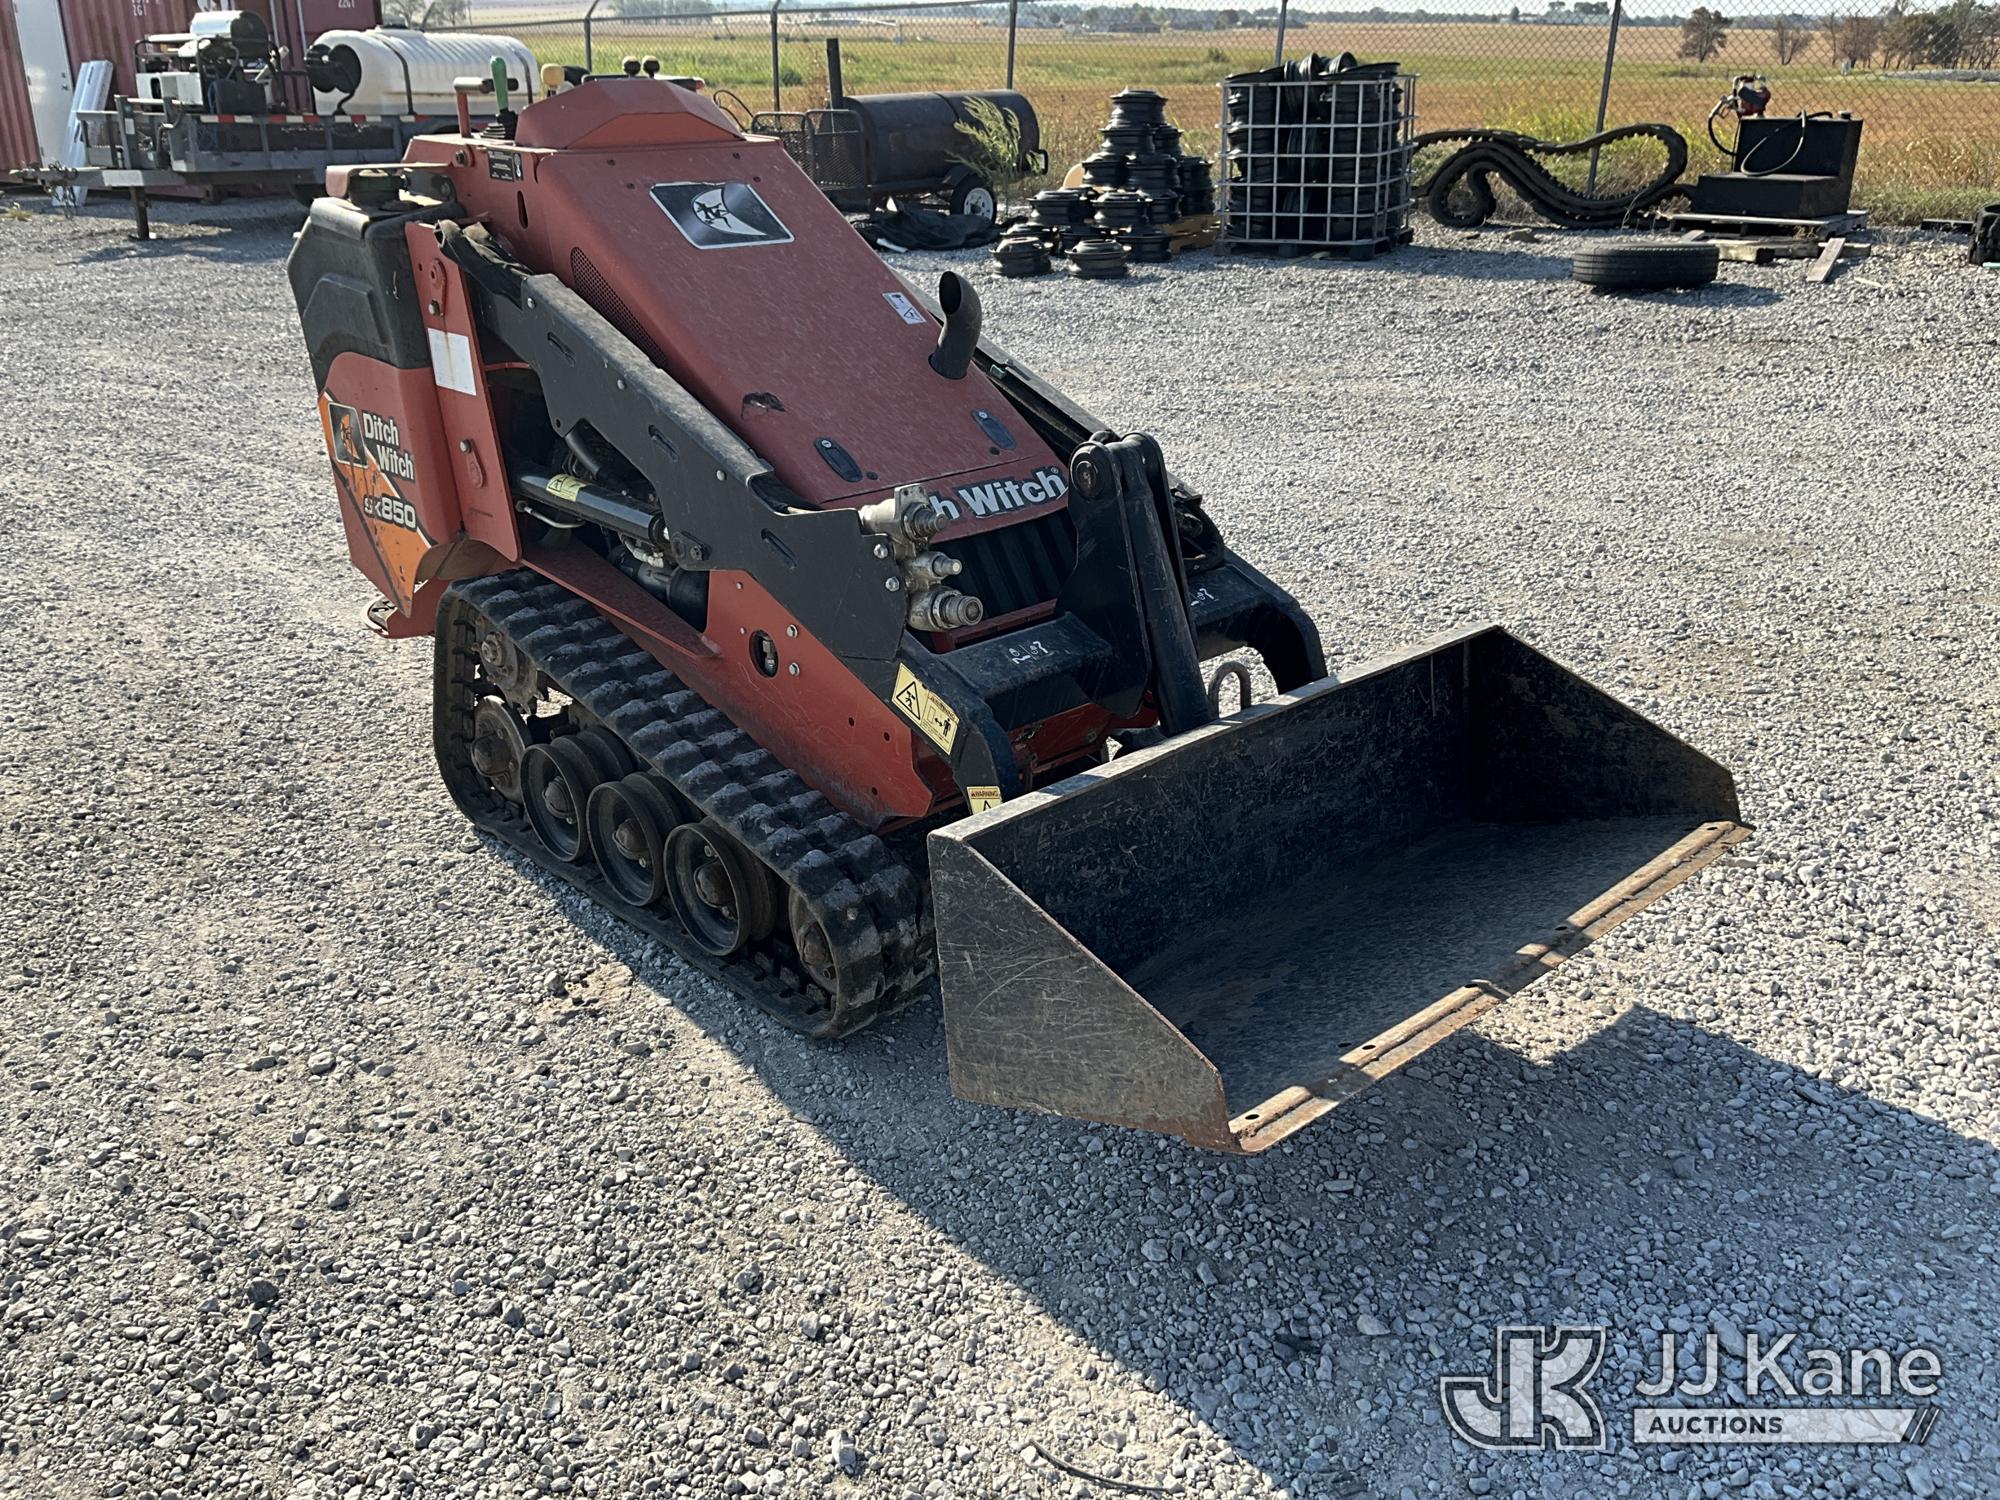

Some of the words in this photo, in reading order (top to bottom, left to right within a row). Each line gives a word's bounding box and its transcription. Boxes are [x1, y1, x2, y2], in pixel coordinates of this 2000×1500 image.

[362, 412, 399, 446] Ditch
[376, 444, 414, 480] Witch
[958, 470, 1065, 515] Witch
